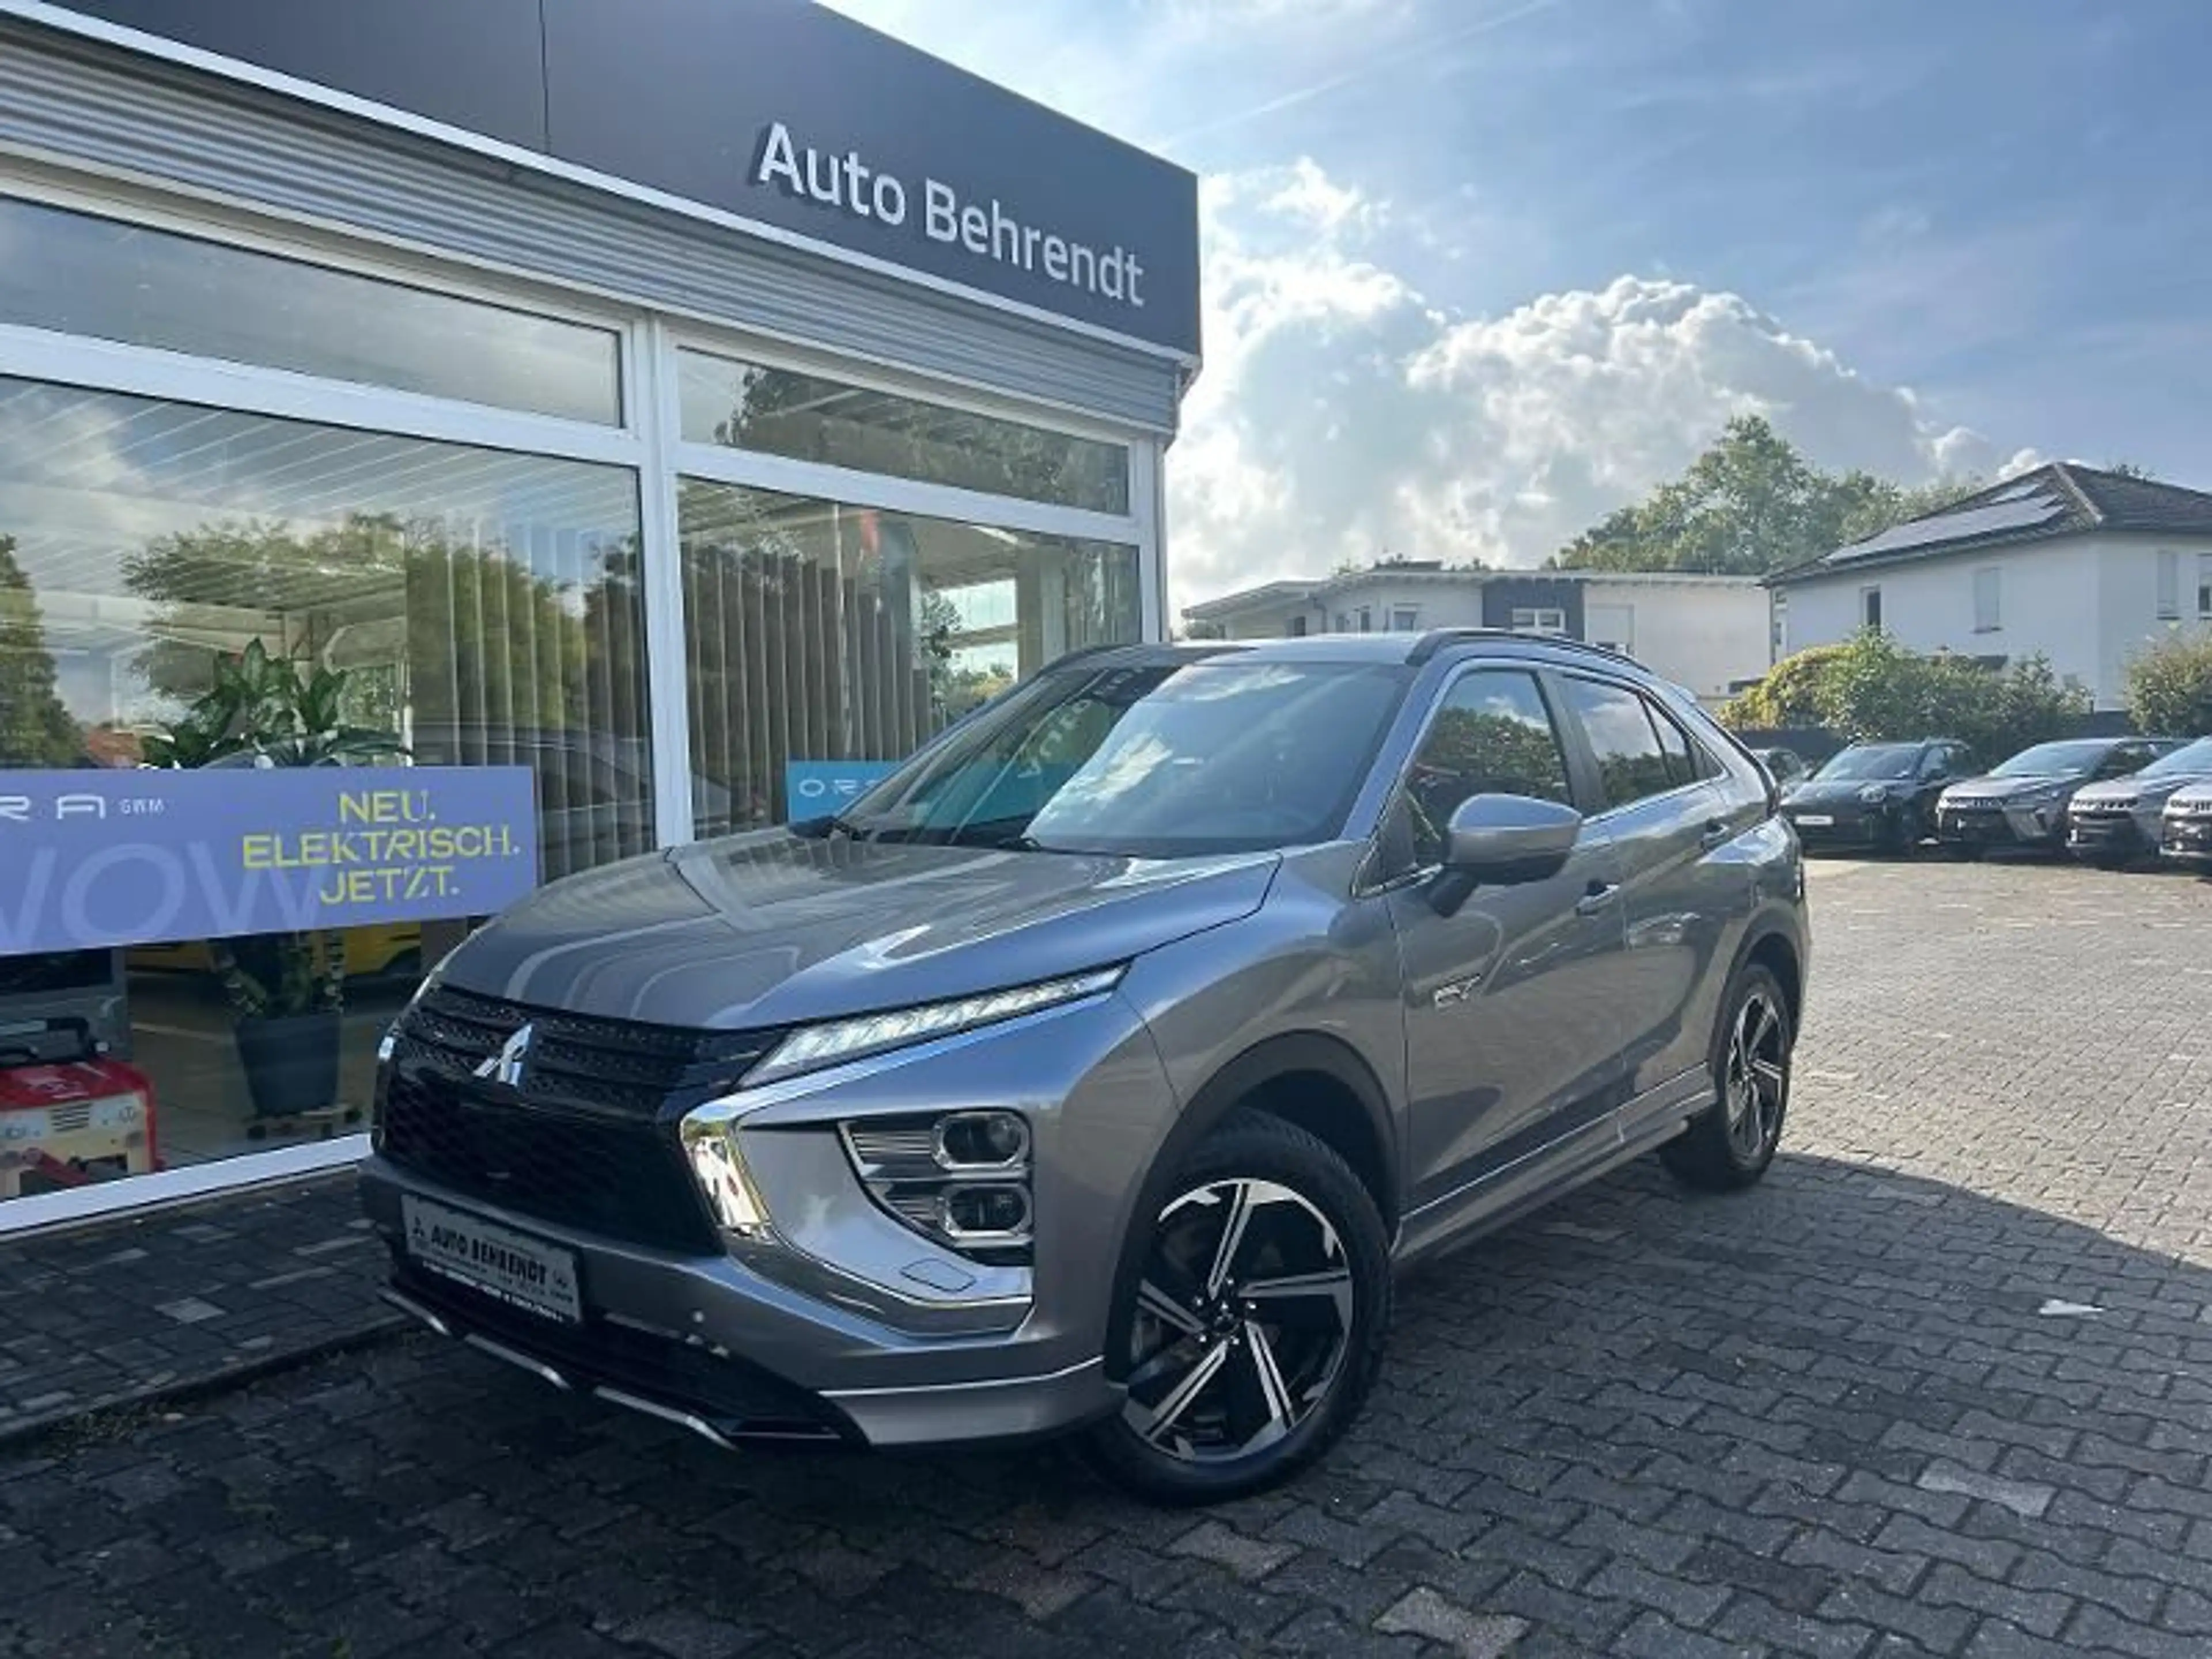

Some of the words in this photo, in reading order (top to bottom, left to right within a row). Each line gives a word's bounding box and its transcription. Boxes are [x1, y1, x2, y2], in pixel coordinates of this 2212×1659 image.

[758, 122, 907, 226] Auto
[925, 177, 1145, 308] Behrendt
[119, 798, 165, 815] GWM
[339, 789, 436, 823] NEU.
[242, 824, 521, 868] ELEKTRISCH.
[320, 865, 460, 904] JETZT.
[430, 1224, 469, 1255] AUTO
